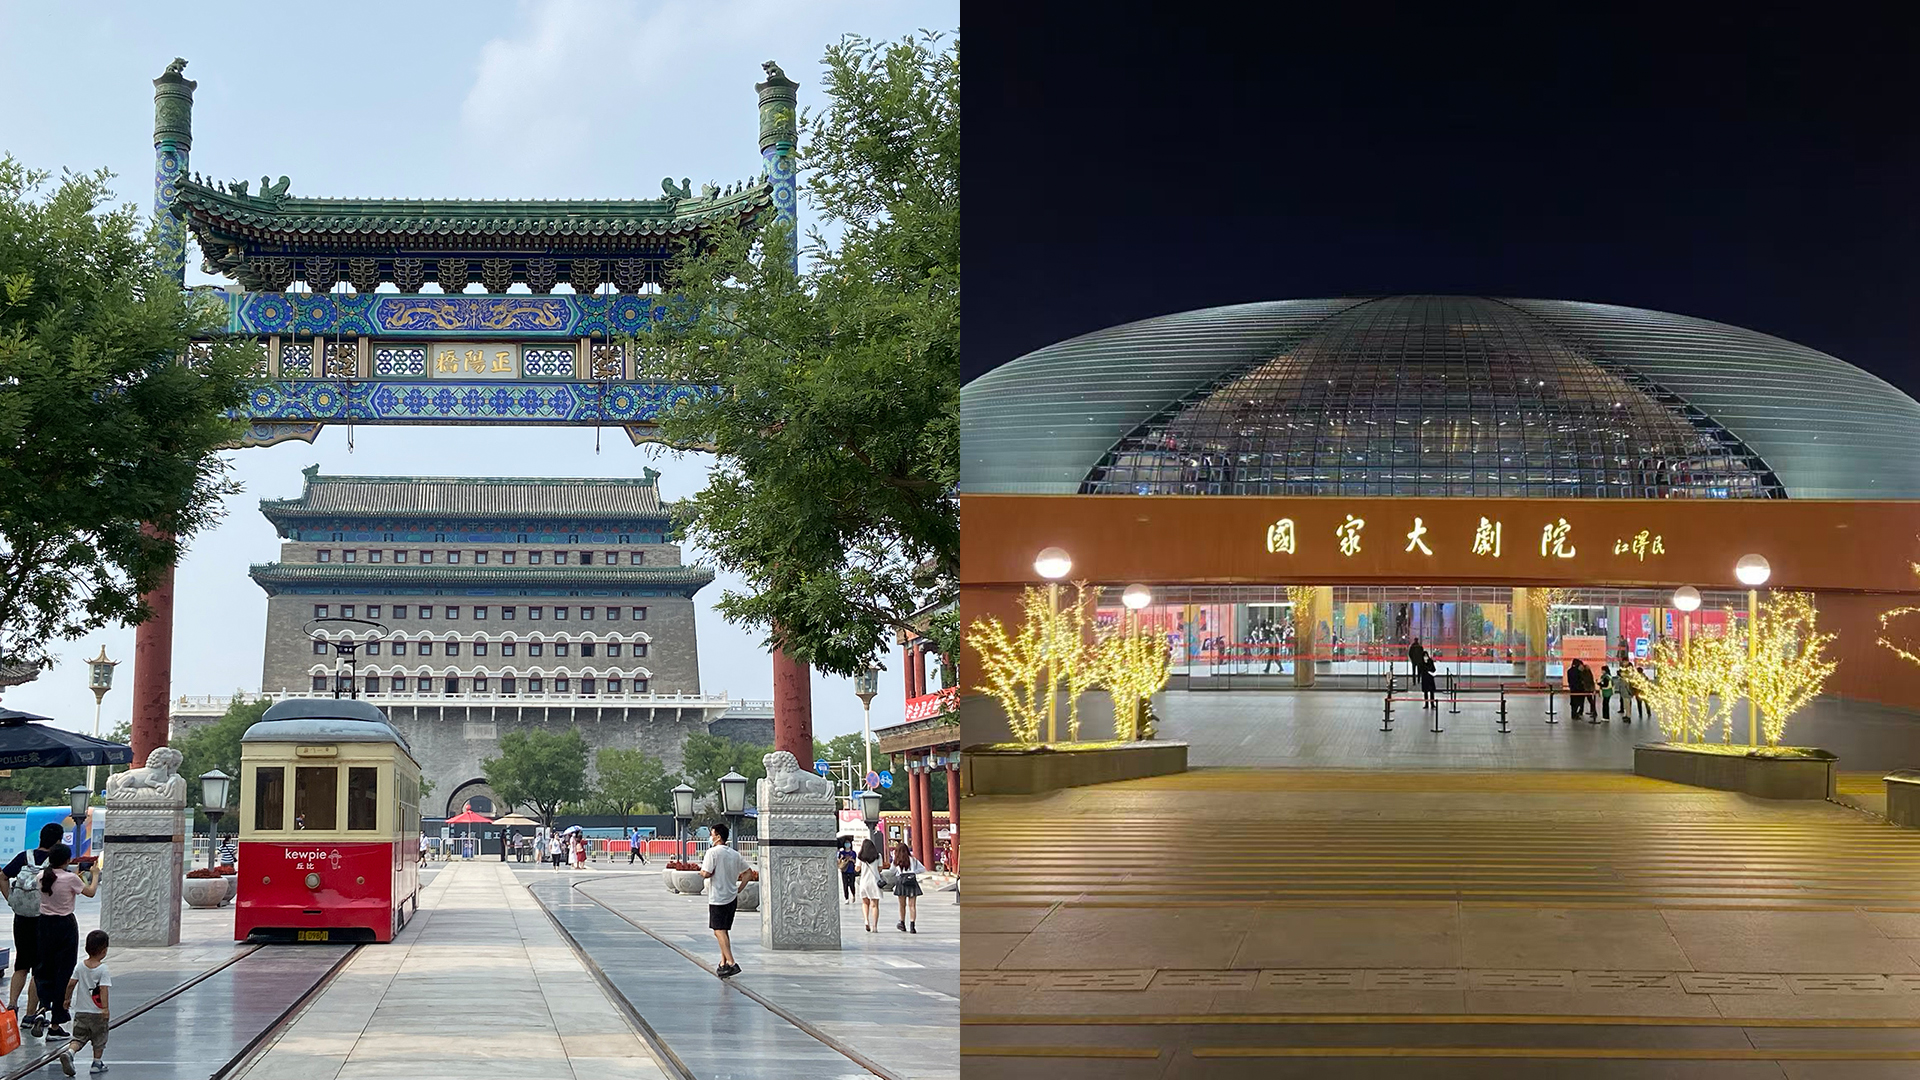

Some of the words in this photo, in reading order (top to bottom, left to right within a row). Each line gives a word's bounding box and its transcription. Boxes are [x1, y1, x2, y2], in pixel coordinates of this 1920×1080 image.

[1266, 513, 1576, 559] 國家大劇院
[285, 848, 327, 862] kewpie
[296, 862, 315, 870] 丘比
